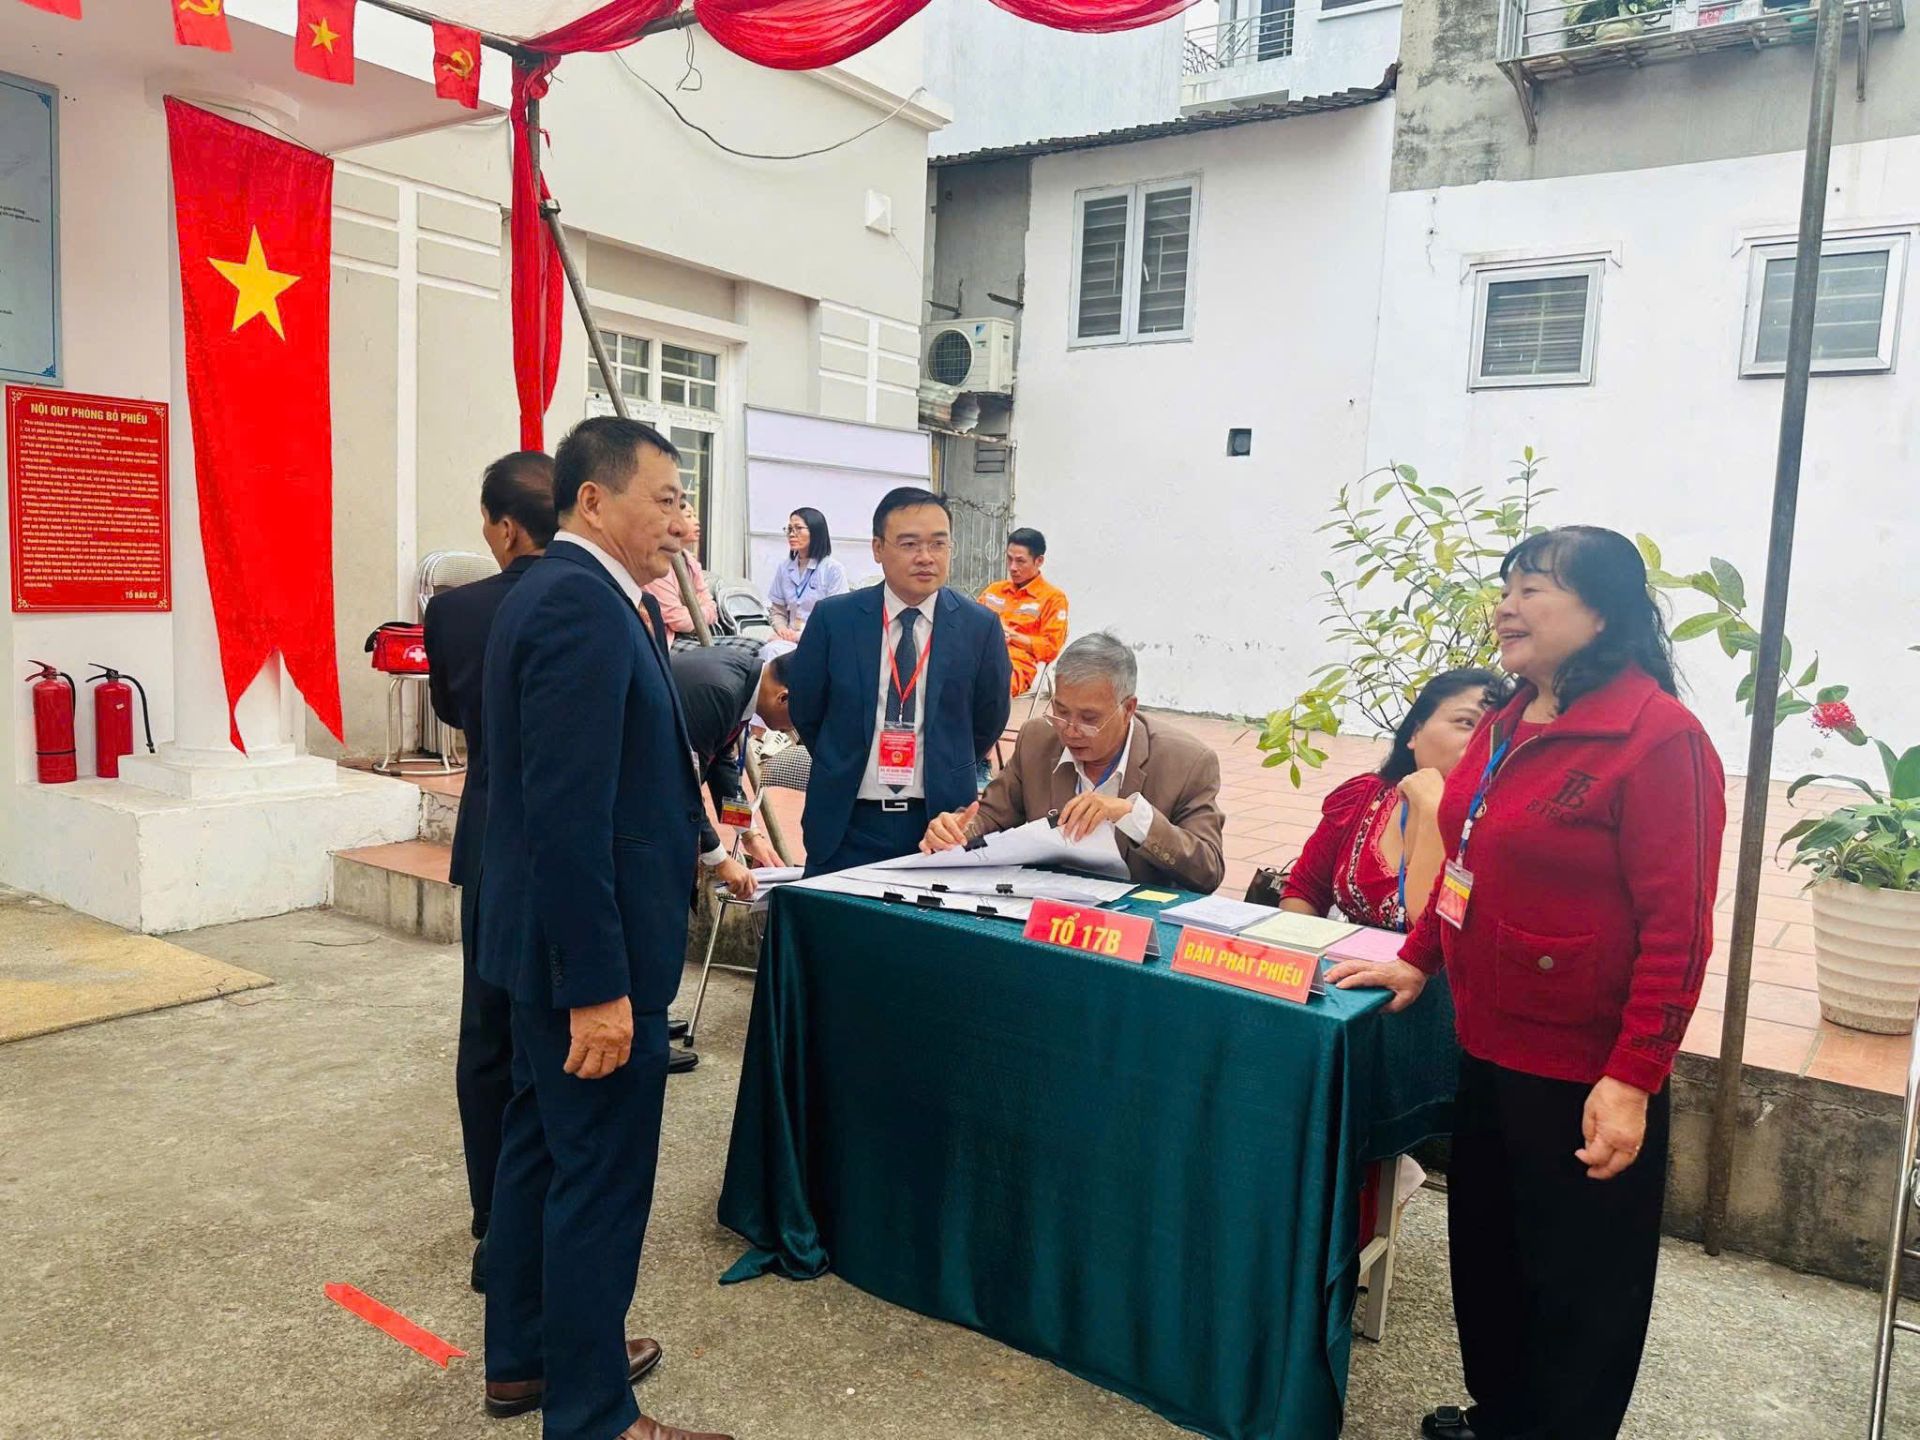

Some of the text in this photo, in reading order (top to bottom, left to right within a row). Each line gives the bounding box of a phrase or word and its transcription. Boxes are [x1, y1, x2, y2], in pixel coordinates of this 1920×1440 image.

[31, 403, 48, 416] NỘI
[51, 405, 69, 417] QUY
[1049, 913, 1122, 955] TỔ 17B
[1256, 960, 1304, 988] PHIẾU
